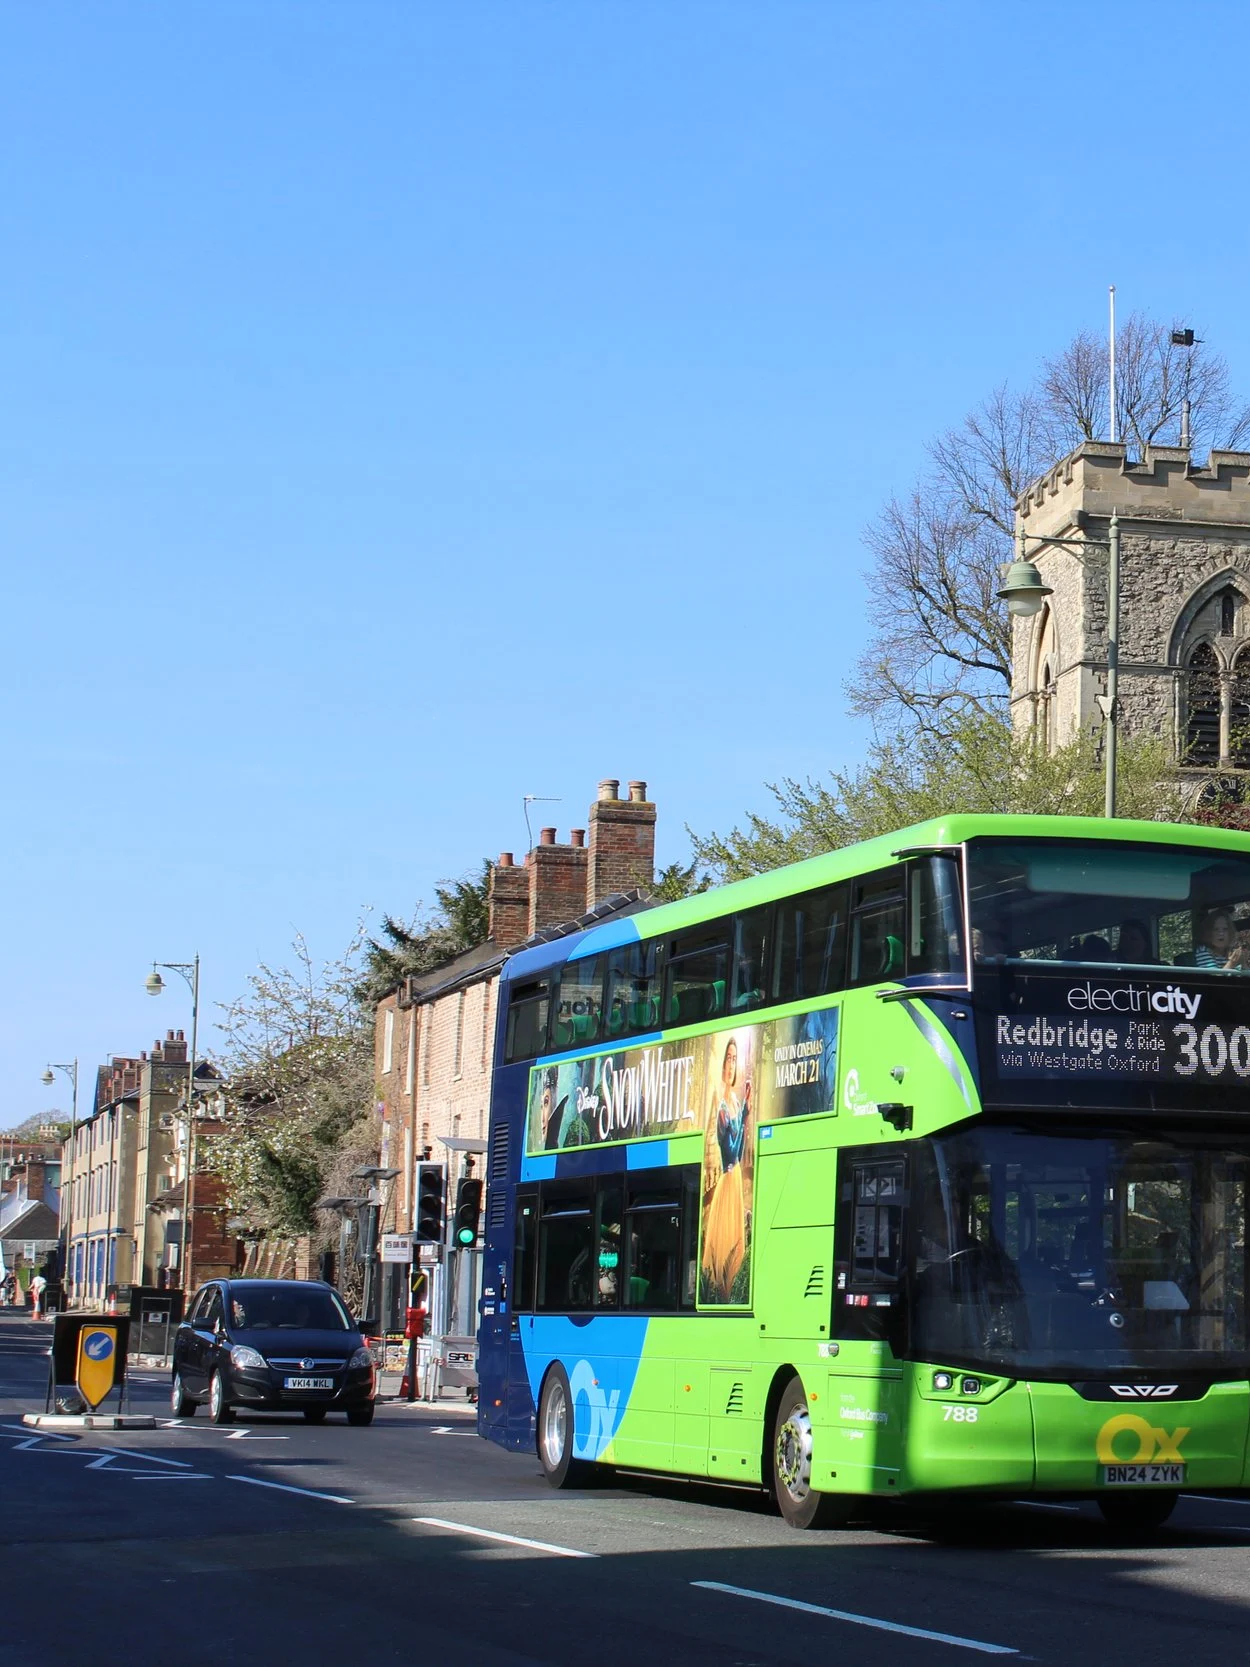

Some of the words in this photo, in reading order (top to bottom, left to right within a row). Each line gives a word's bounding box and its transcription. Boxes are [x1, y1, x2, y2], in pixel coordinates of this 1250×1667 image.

[1067, 981, 1202, 1020] electricity
[997, 1015, 1118, 1054] Redbridge
[1129, 1021, 1160, 1035] Park
[775, 1047, 789, 1062] ONLY
[789, 1044, 797, 1060] IN
[796, 1039, 823, 1058] CINEMAS
[1124, 1036, 1135, 1050] &
[1137, 1036, 1166, 1051] Ride
[1001, 1050, 1023, 1067] via
[1028, 1051, 1102, 1071] Westgate
[1107, 1054, 1160, 1072] Oxford
[775, 1061, 808, 1088] MARCH
[808, 1058, 820, 1082] 21
[576, 1086, 599, 1118] Disney
[599, 1056, 644, 1140] SNOW
[642, 1047, 695, 1123] WHITE
[449, 1352, 473, 1361] SRL
[941, 1405, 978, 1423] 788
[1096, 1413, 1191, 1464] Ox
[1107, 1466, 1147, 1482] BN24
[1150, 1466, 1180, 1482] ZYK
